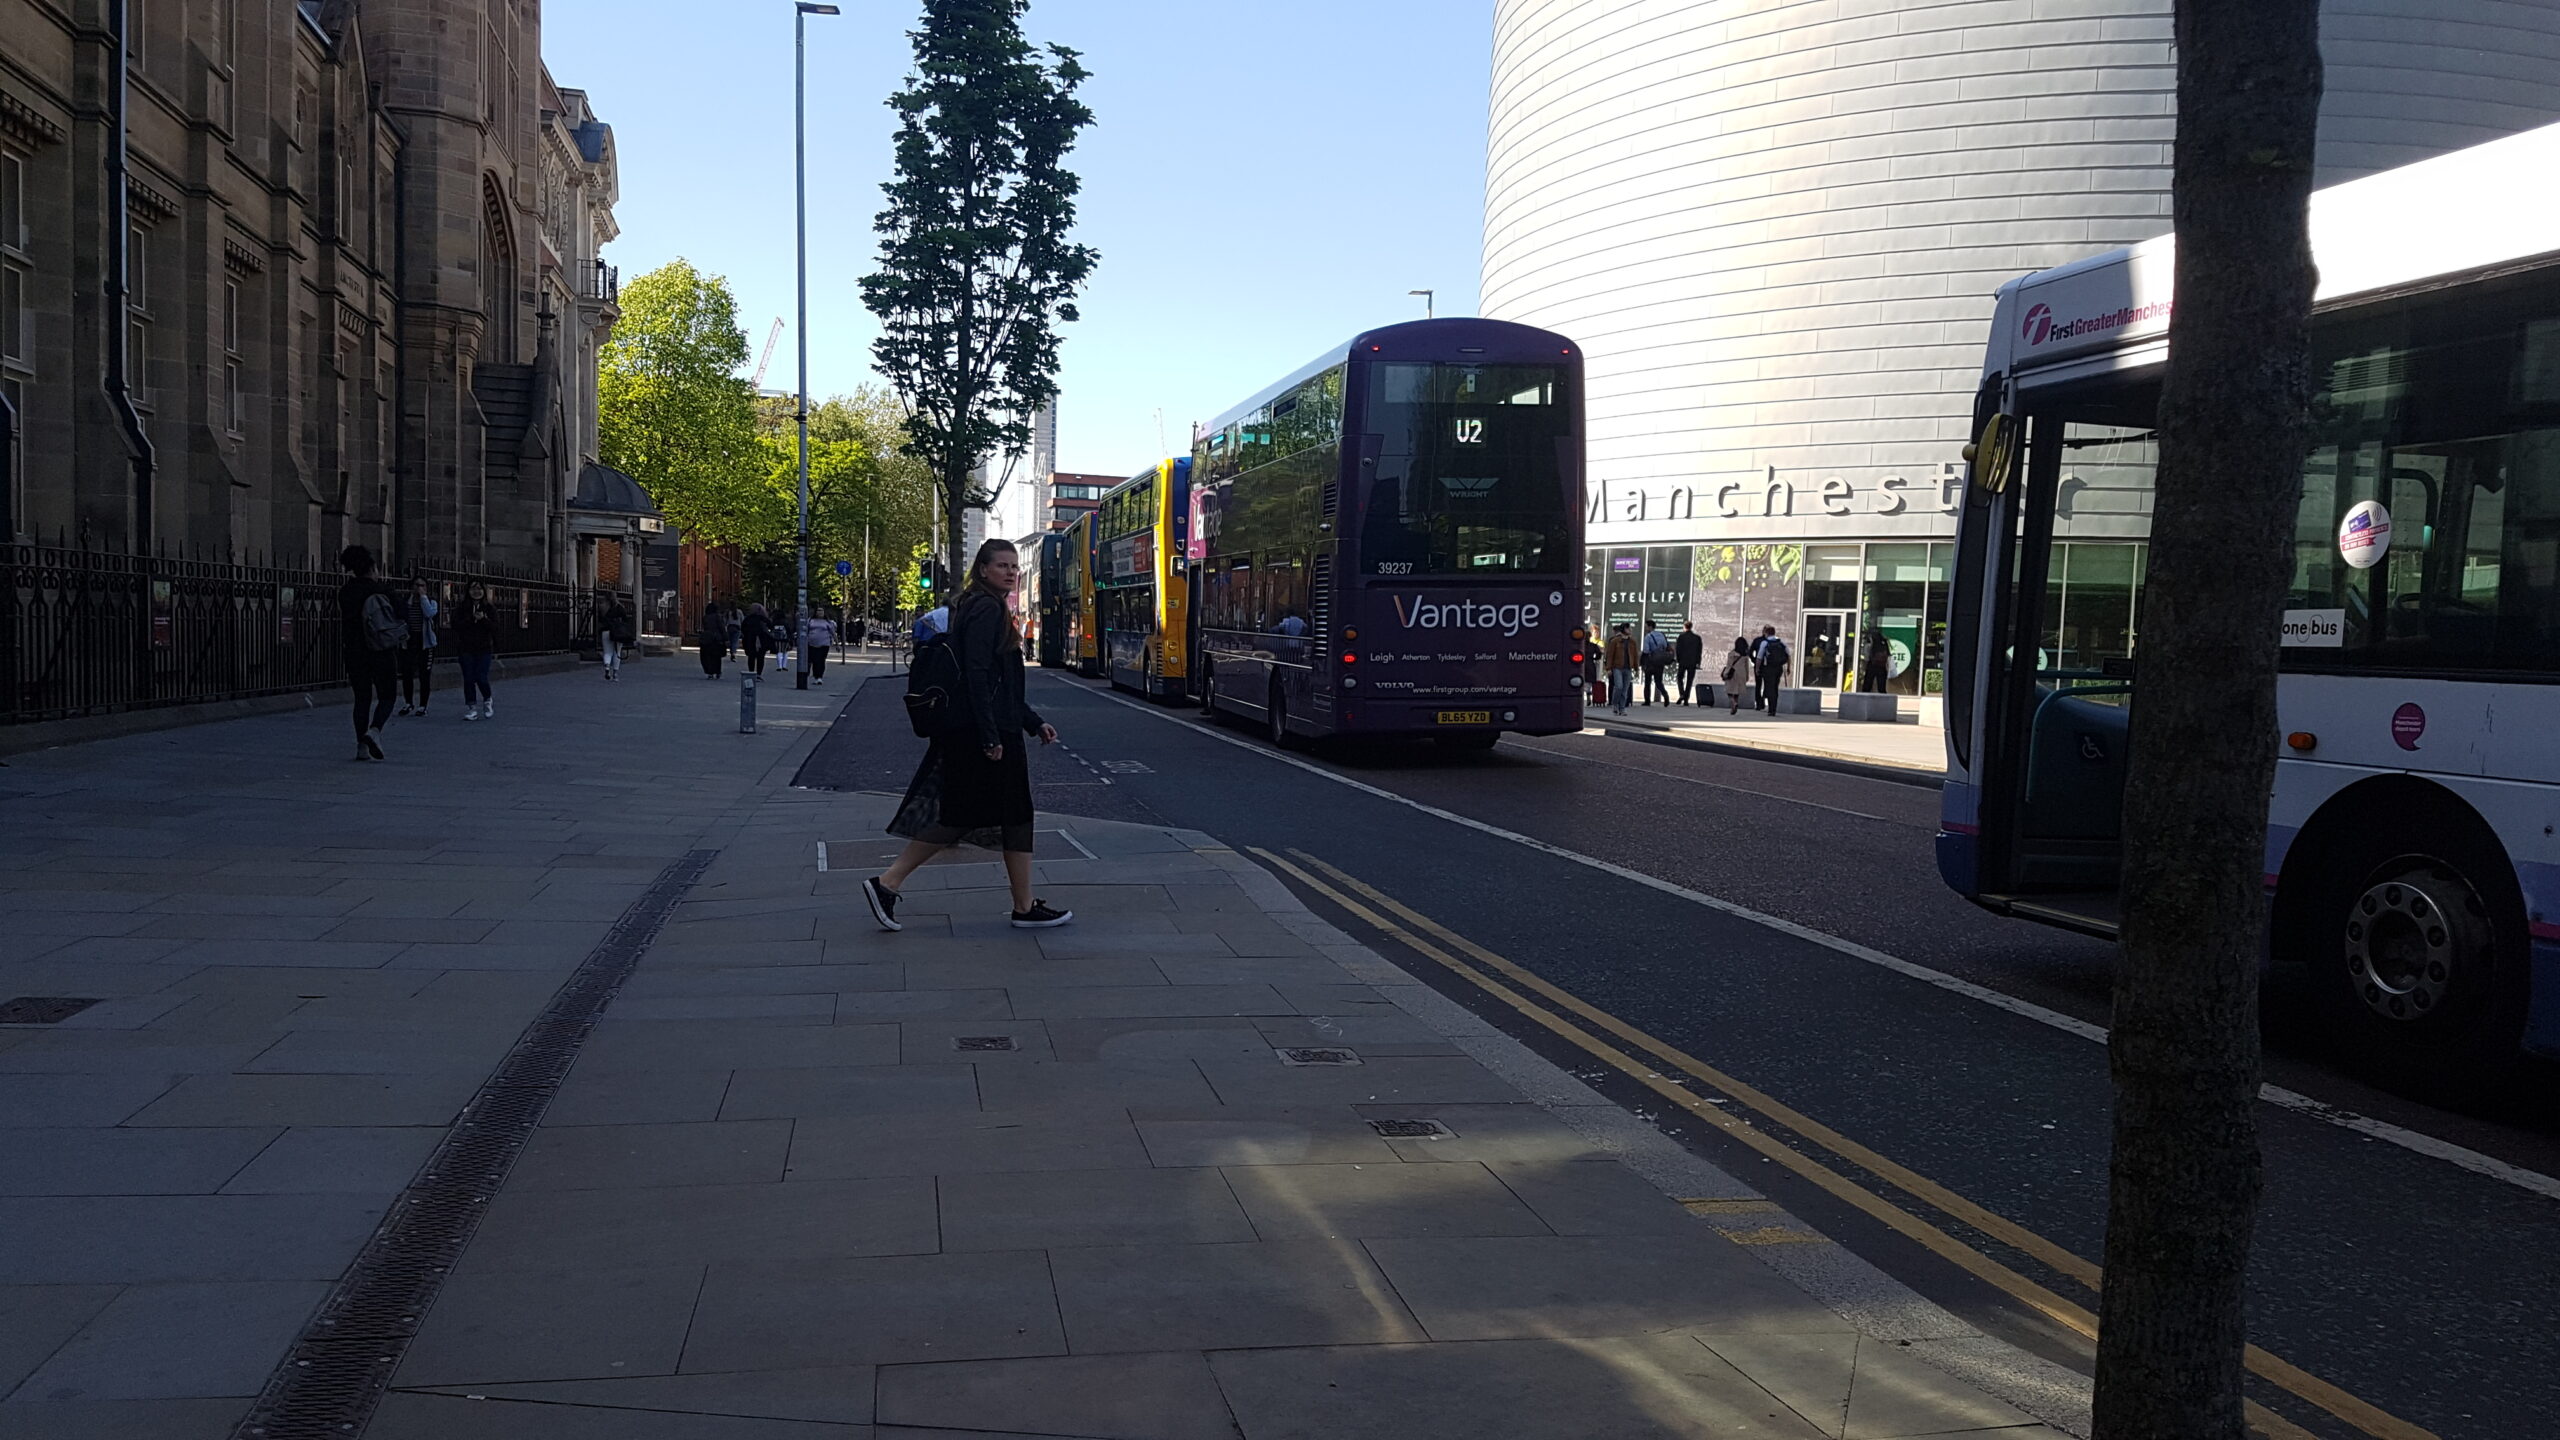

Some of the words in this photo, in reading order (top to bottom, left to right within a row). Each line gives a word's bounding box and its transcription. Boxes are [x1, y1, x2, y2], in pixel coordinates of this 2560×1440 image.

[1449, 490, 1489, 498] WRIGHT
[1584, 462, 2088, 524] Manchestr
[1378, 562, 1413, 575] 39237
[1610, 591, 1686, 604] STELLIFY
[1393, 594, 1540, 638] Vantage
[1369, 652, 1395, 664] Leigh
[1401, 652, 1431, 661] Atherton
[1437, 652, 1467, 663] Tyldesley
[1474, 652, 1497, 661] Salford
[1508, 651, 1558, 662] Manchester
[1413, 685, 1517, 694] www.firstgroup.com/vantage
[1441, 712, 1466, 723] BL65
